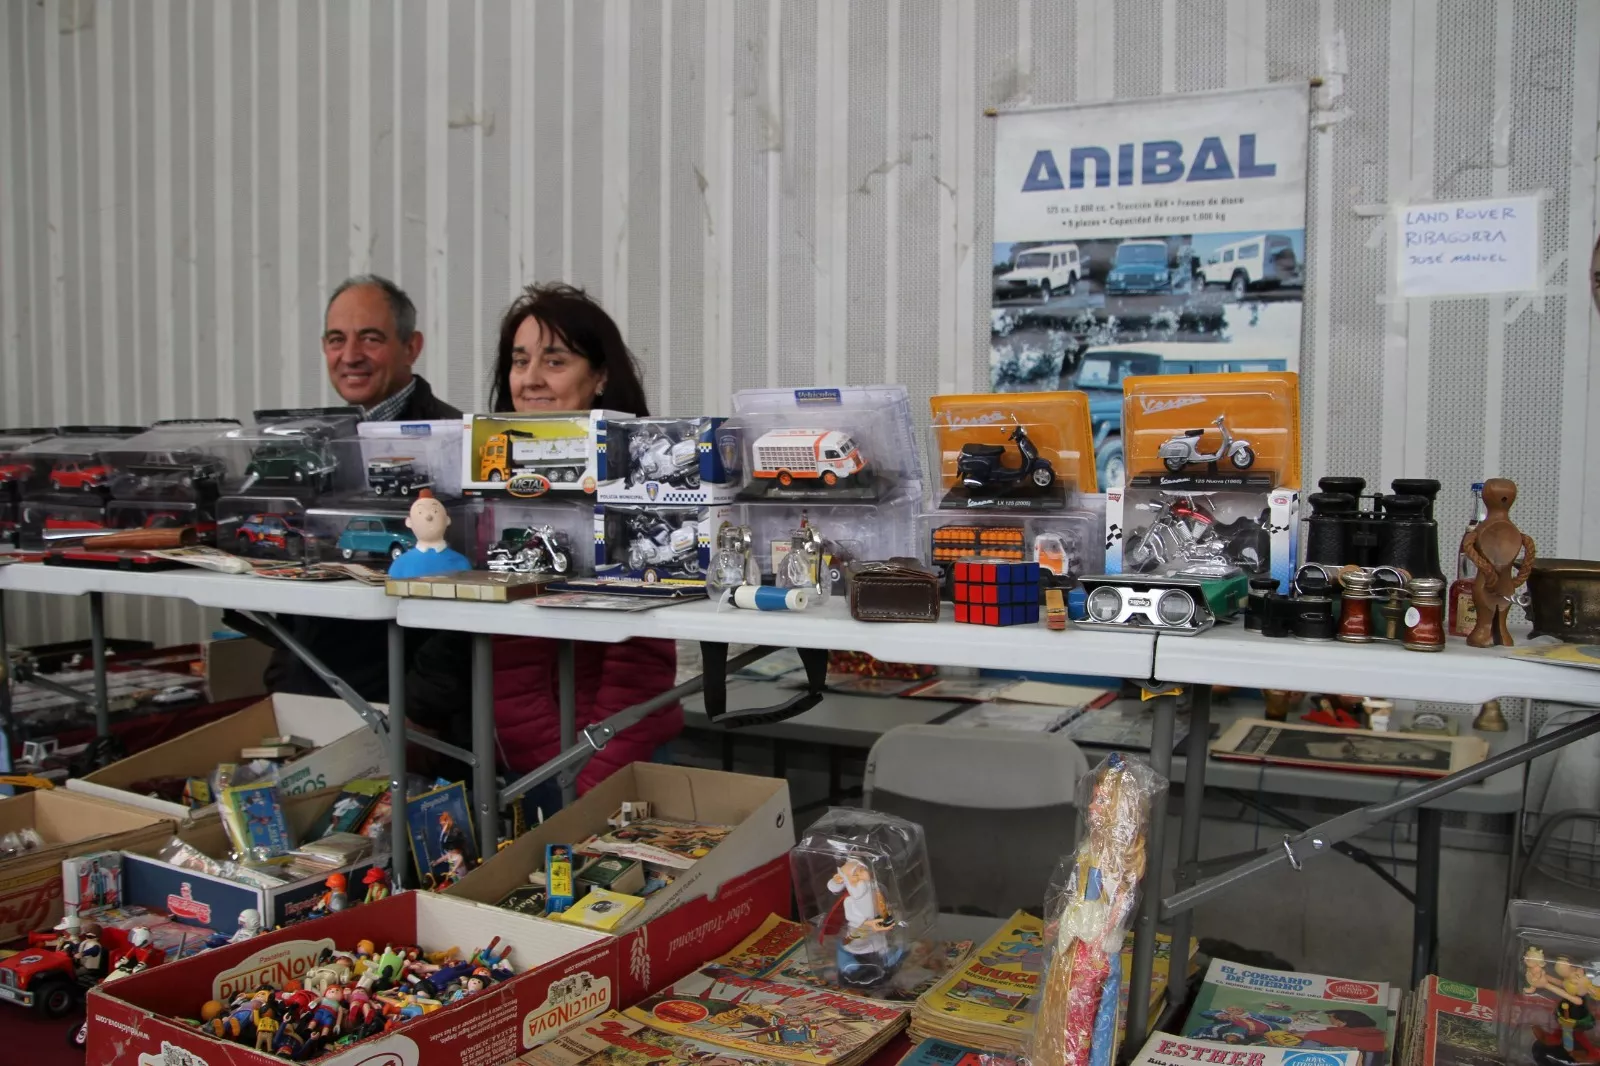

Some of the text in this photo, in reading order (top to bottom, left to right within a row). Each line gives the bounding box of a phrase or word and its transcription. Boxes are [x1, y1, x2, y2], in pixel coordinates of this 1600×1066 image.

[1021, 134, 1277, 192] ANIBAL
[1109, 214, 1151, 226] Capacidad
[1154, 214, 1164, 223] de
[1215, 211, 1226, 223] kg
[1406, 207, 1516, 225] LAND ROVER
[1139, 392, 1208, 415] Vespa
[945, 410, 1007, 431] Vespa
[511, 479, 545, 489] METAL
[724, 898, 753, 925] Sabor
[665, 914, 725, 962] Tradicional
[220, 952, 318, 1001] DULCINOV
[1220, 965, 1313, 986] EL CORSARIO
[1225, 973, 1304, 992] DE HIERRO
[528, 987, 607, 1038] DULCINOVA
[1154, 1039, 1266, 1066] ESTHER
